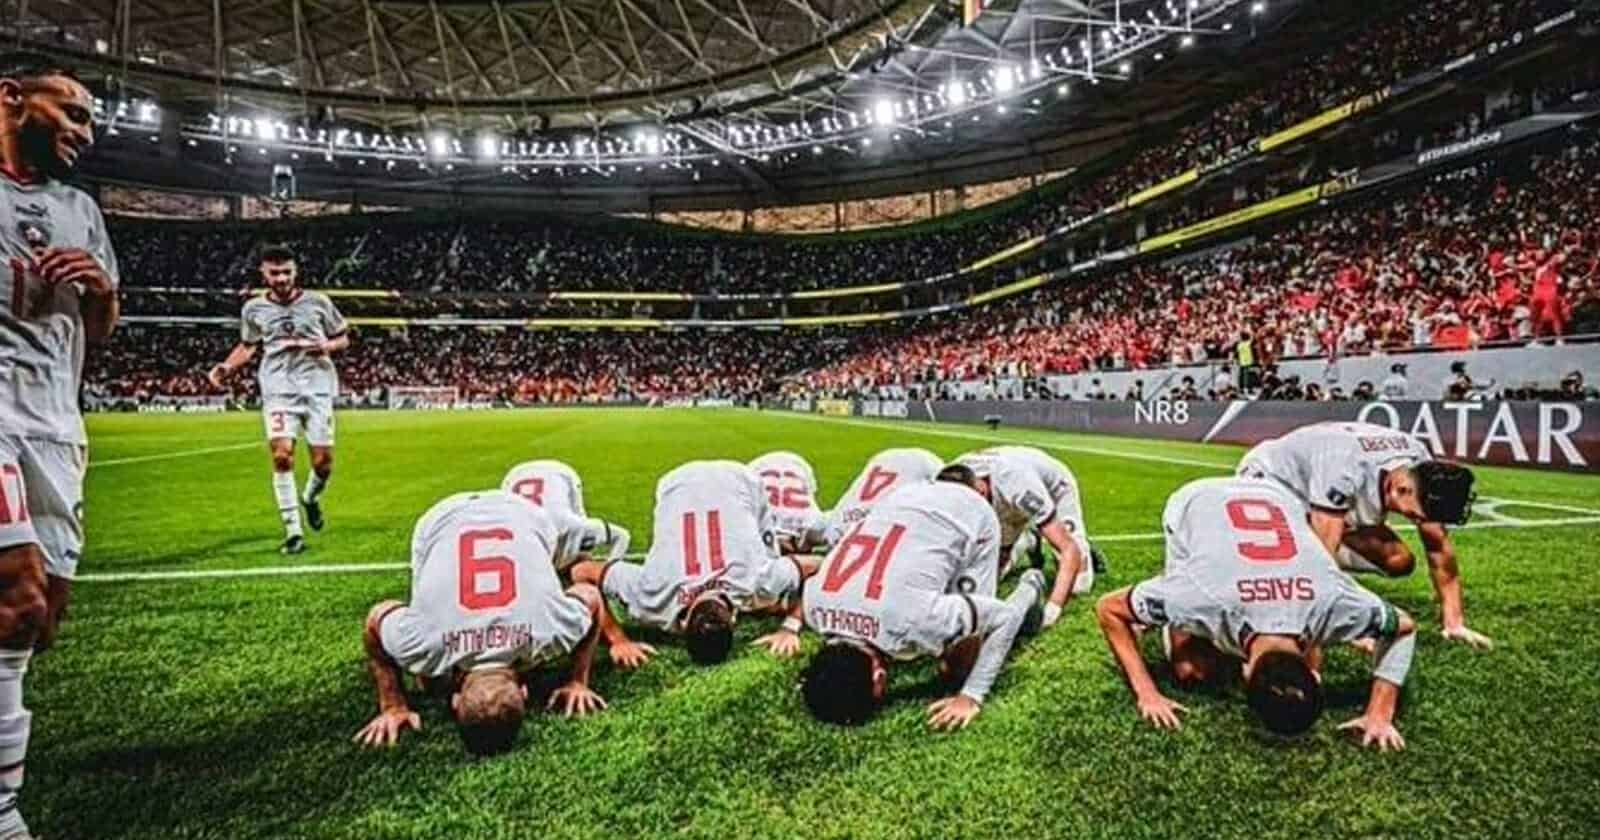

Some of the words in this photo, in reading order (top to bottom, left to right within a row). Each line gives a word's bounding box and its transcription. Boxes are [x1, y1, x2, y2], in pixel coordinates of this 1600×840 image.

[270, 410, 287, 432] 3
[1133, 400, 1190, 425] NR8
[859, 466, 898, 502] 4
[683, 511, 725, 577] 11
[1225, 500, 1298, 561] 6
[458, 529, 516, 611] 9
[821, 522, 906, 600] 14
[1236, 577, 1315, 603] SAISS
